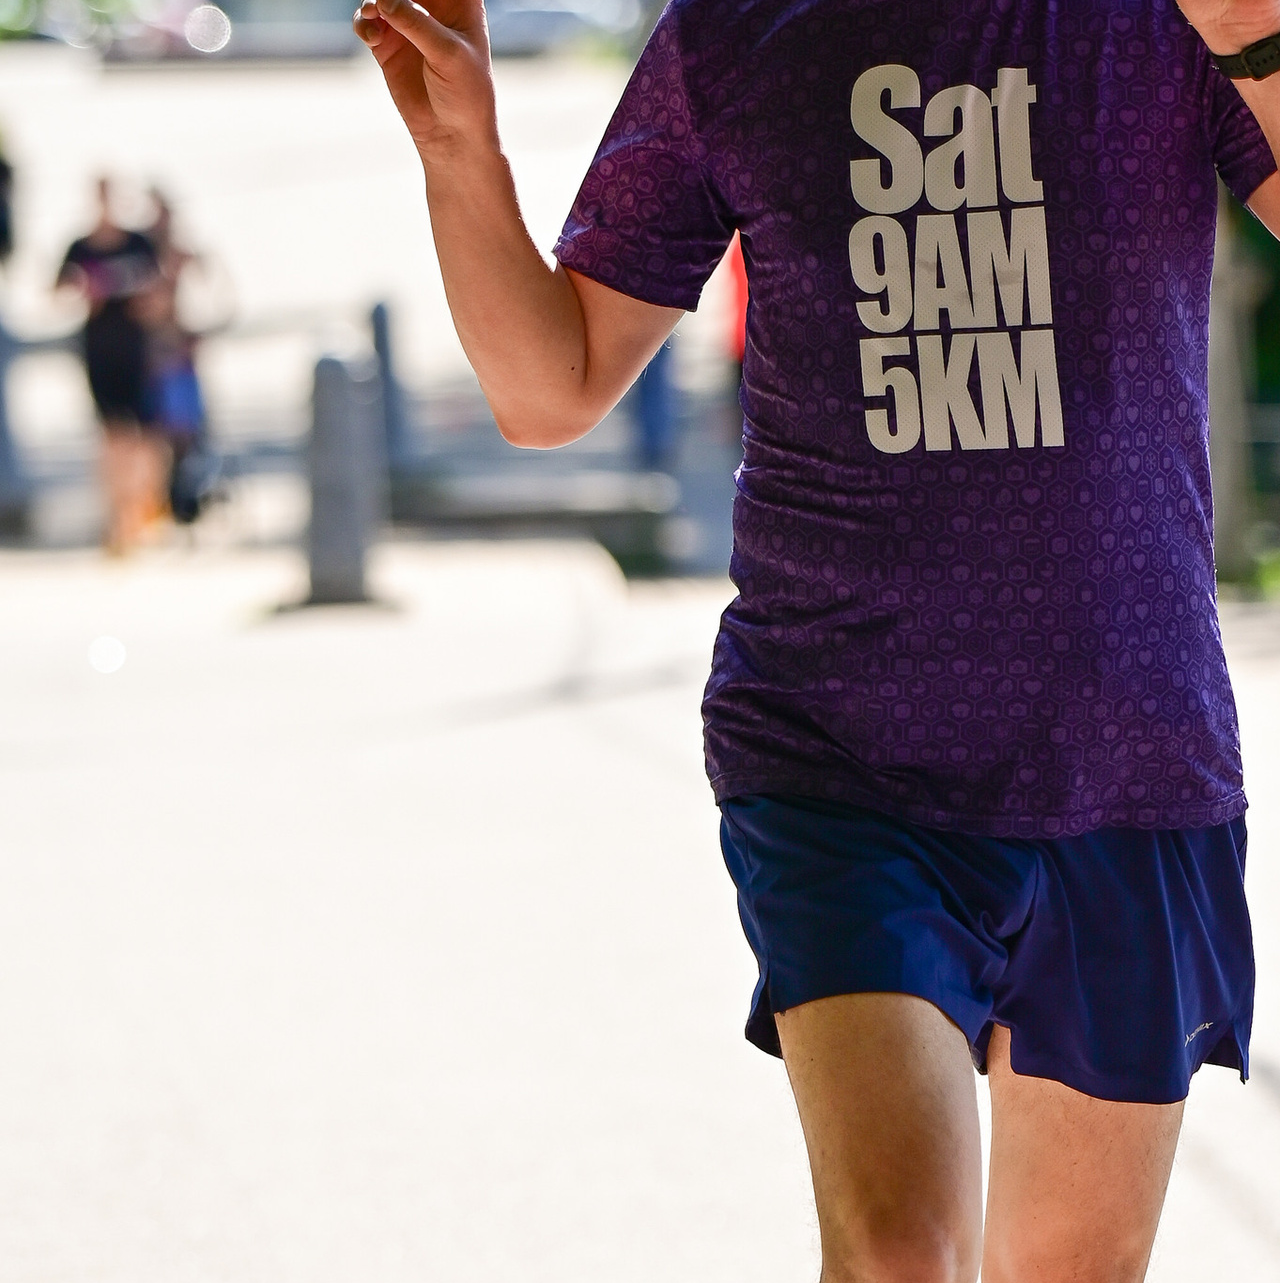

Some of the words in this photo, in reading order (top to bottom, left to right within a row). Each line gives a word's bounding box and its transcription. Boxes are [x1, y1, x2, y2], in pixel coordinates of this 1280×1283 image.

[849, 63, 1045, 215] Sat
[848, 205, 1053, 334] 9AM
[859, 329, 1065, 455] 5KM
